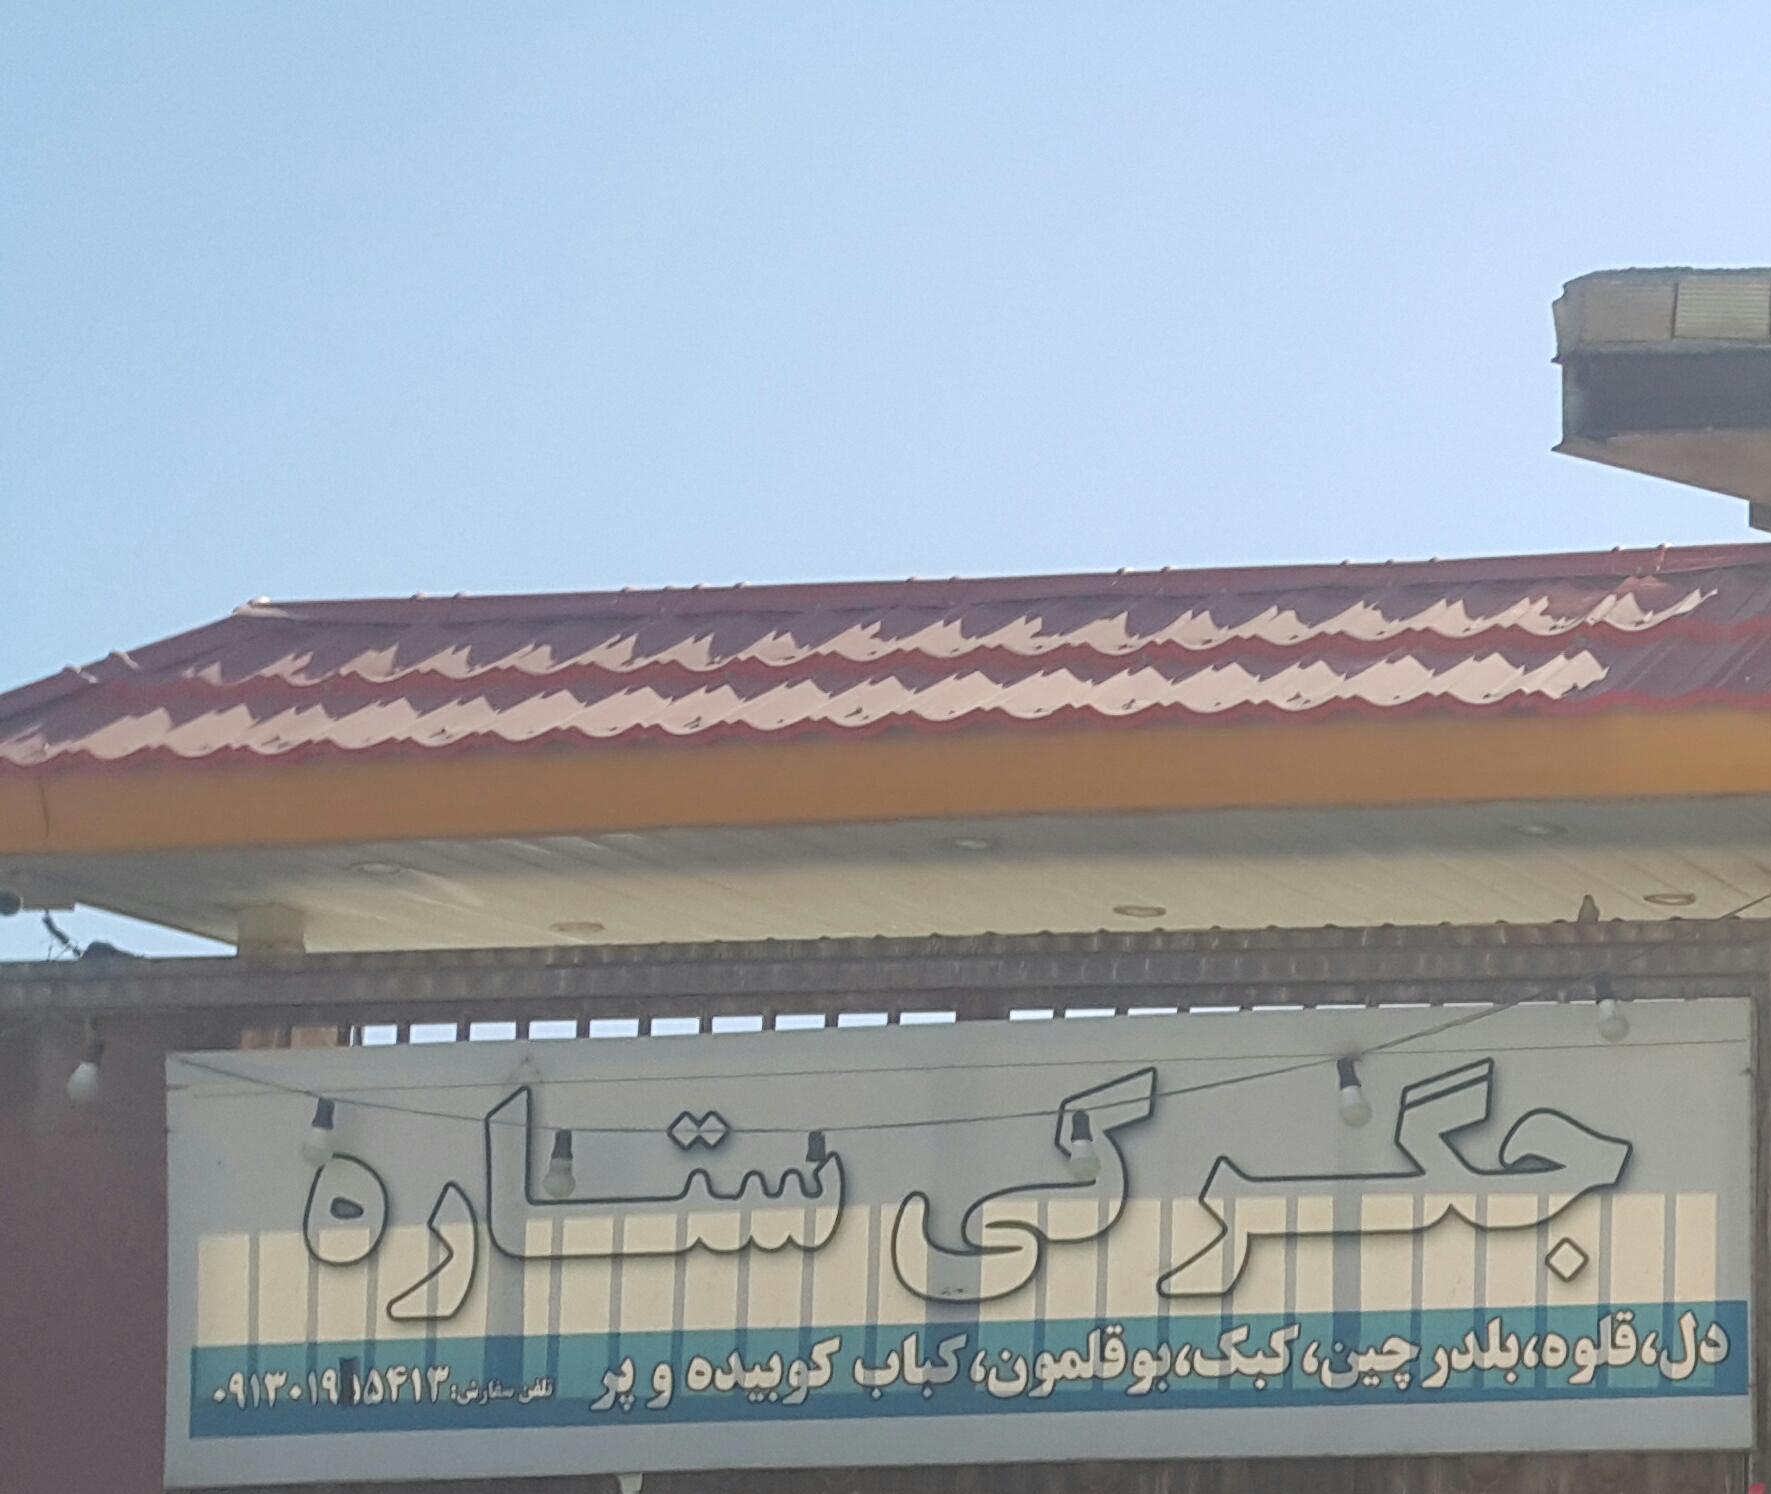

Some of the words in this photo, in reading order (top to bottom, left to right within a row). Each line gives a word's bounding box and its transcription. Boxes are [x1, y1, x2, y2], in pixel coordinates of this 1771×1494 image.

[303, 1085, 846, 1321] ستاره
[518, 1377, 554, 1405] تلفن
[588, 1356, 635, 1412] پر
[646, 1361, 675, 1410] و
[686, 1334, 842, 1406] کوبیده
[852, 1332, 969, 1400] کباب
